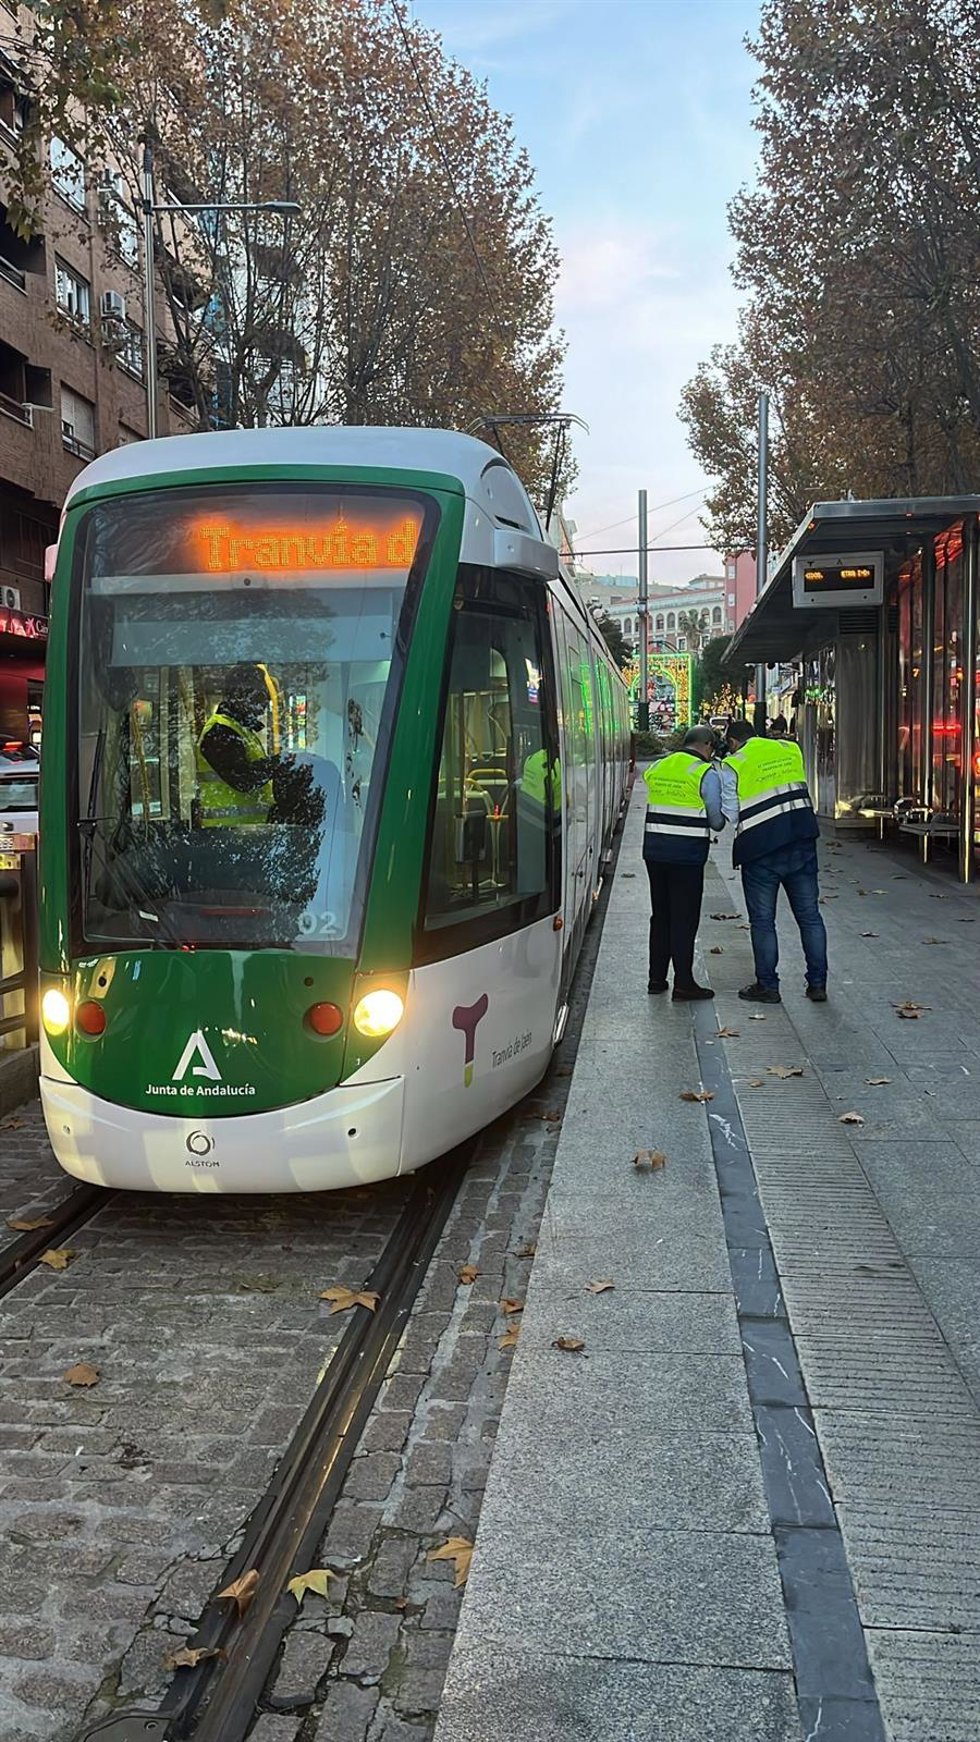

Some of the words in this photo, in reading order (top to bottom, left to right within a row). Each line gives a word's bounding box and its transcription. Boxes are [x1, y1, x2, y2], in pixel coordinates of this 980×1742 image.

[200, 523, 378, 568] Tranvía
[298, 911, 337, 934] 02
[145, 1084, 178, 1095] Junta
[180, 1085, 194, 1095] de
[196, 1084, 256, 1096] Andalucía
